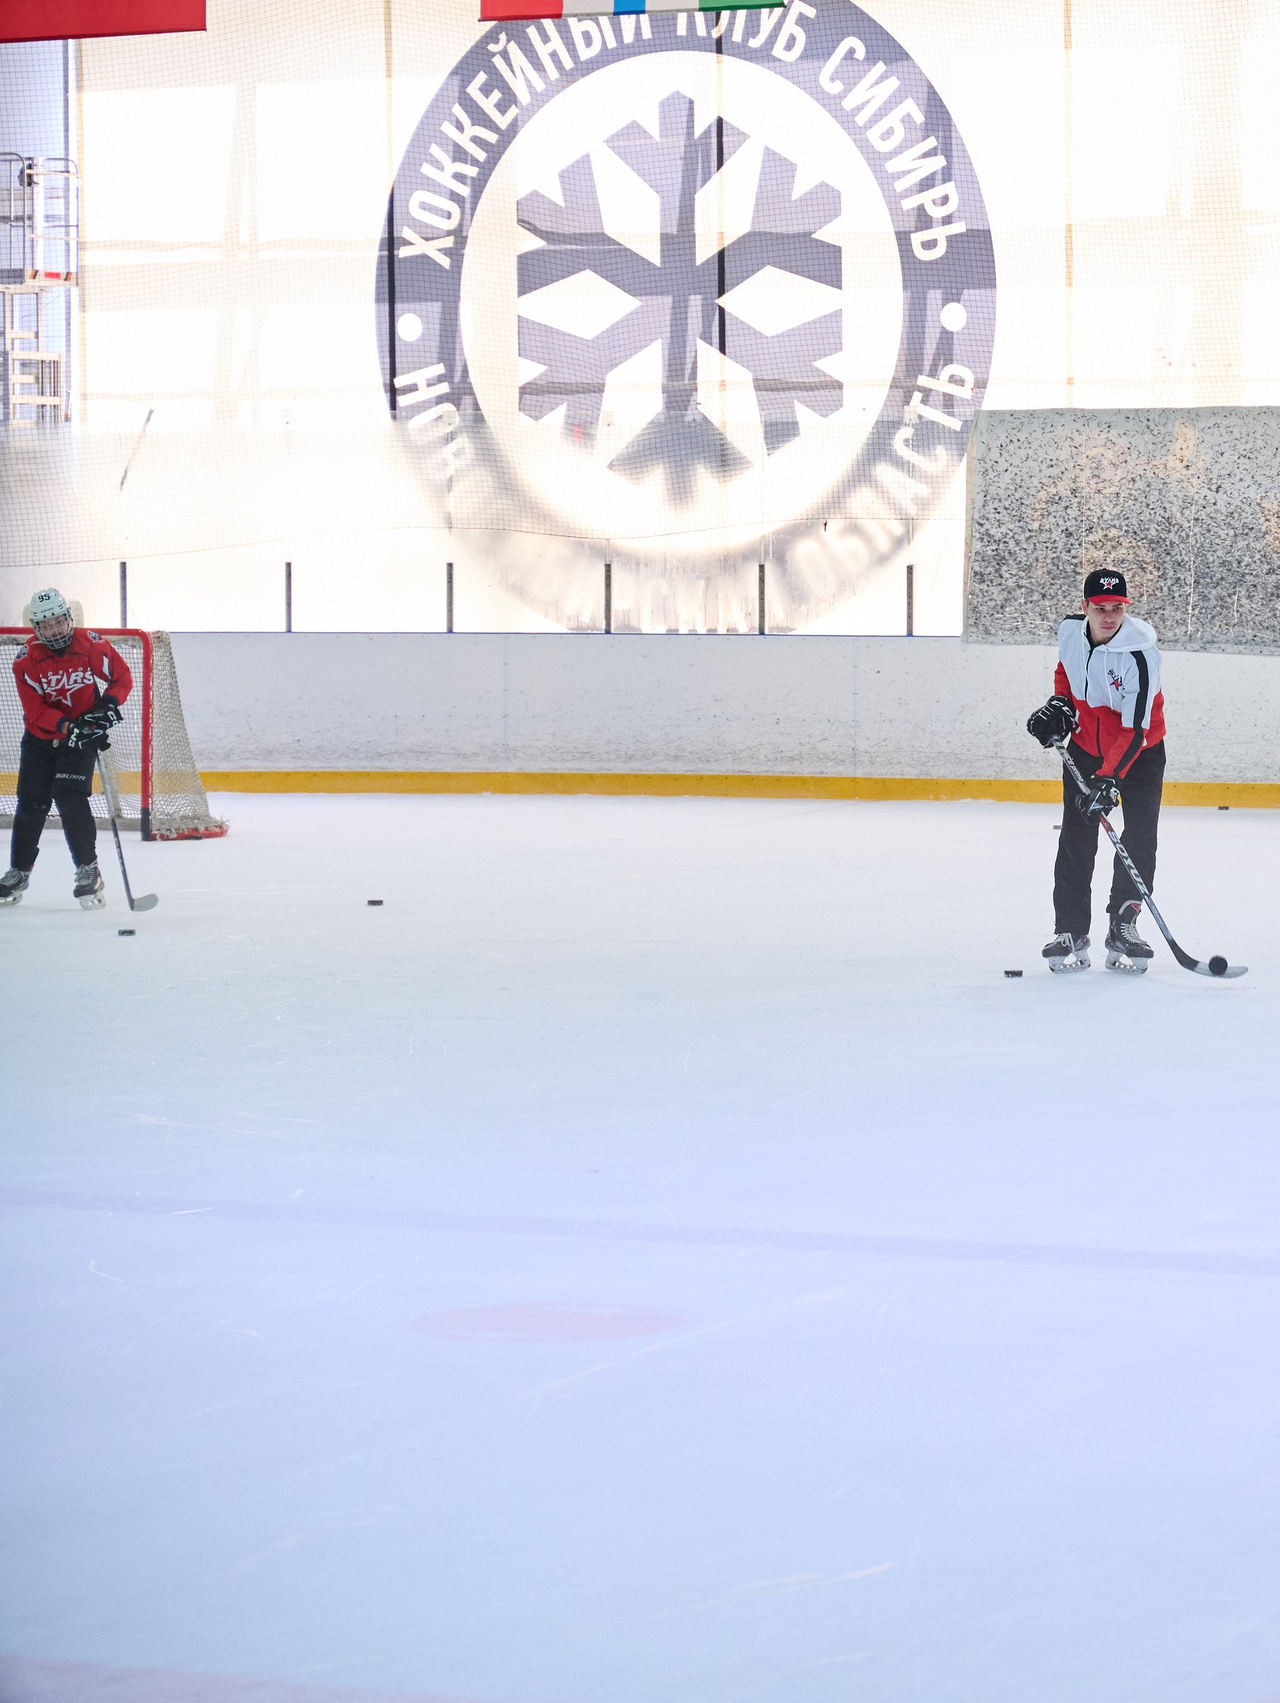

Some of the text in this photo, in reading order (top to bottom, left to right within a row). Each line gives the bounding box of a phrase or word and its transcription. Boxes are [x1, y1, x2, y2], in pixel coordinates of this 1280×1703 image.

[818, 36, 967, 262] СИБИРЬ
[37, 593, 51, 603] 95
[1108, 830, 1150, 896] SOYUZ
